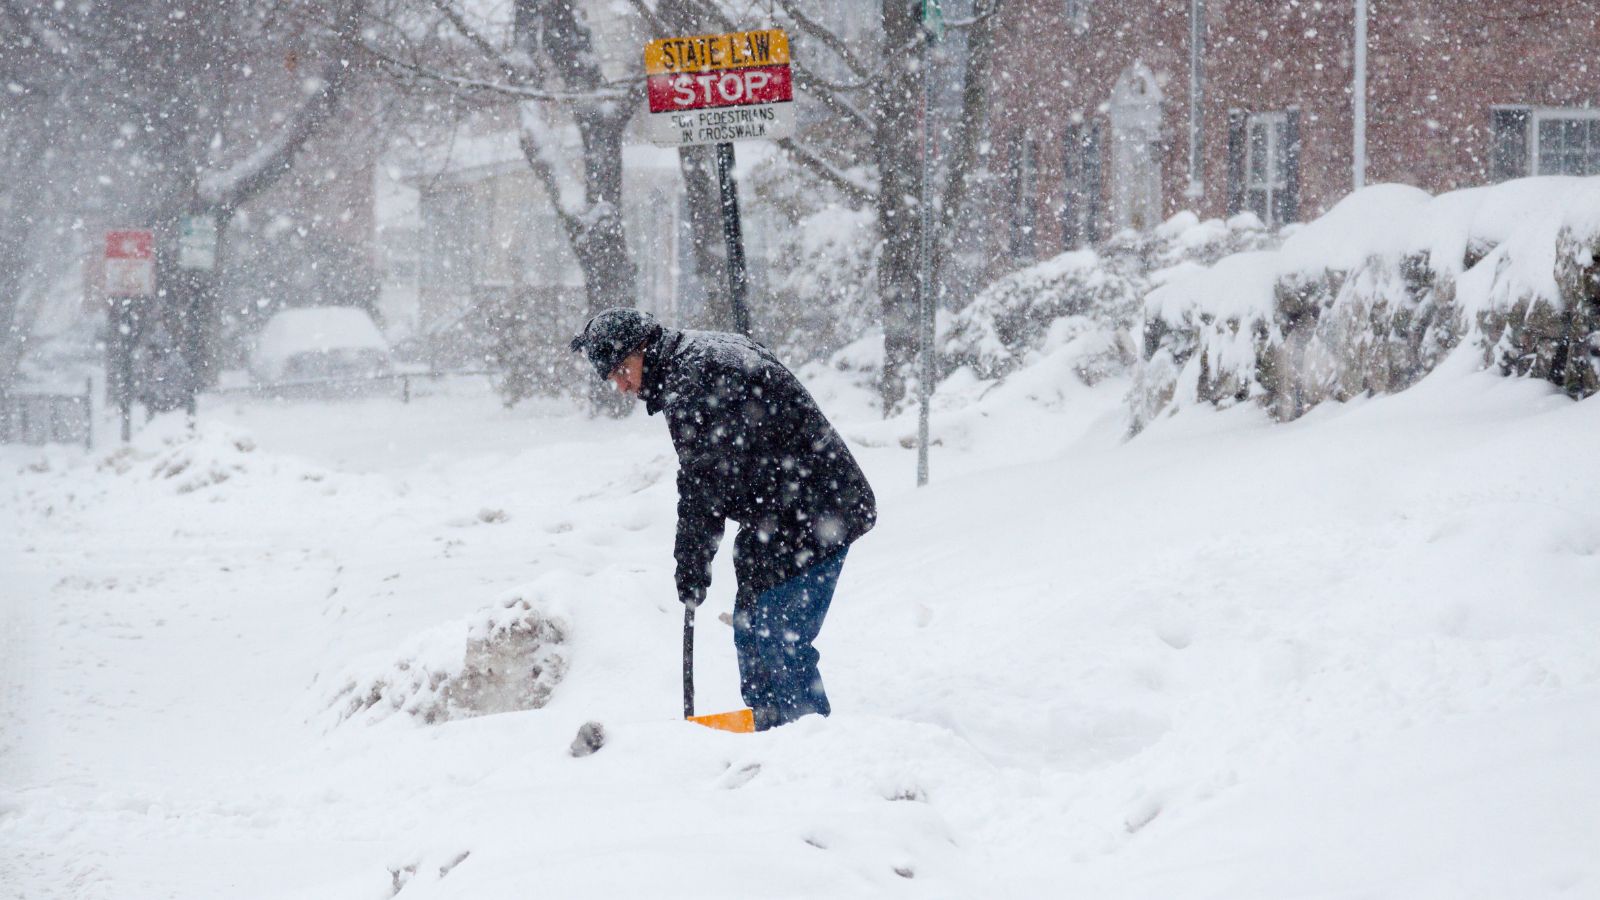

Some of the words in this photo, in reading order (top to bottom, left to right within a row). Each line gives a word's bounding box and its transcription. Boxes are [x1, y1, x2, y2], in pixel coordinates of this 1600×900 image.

[663, 38, 721, 69] STATE
[730, 33, 770, 64] LAW
[673, 71, 769, 106] STOP
[699, 107, 775, 126] PEDESTRIANS
[682, 131, 693, 143] IN
[699, 124, 766, 141] CROSSWALK
